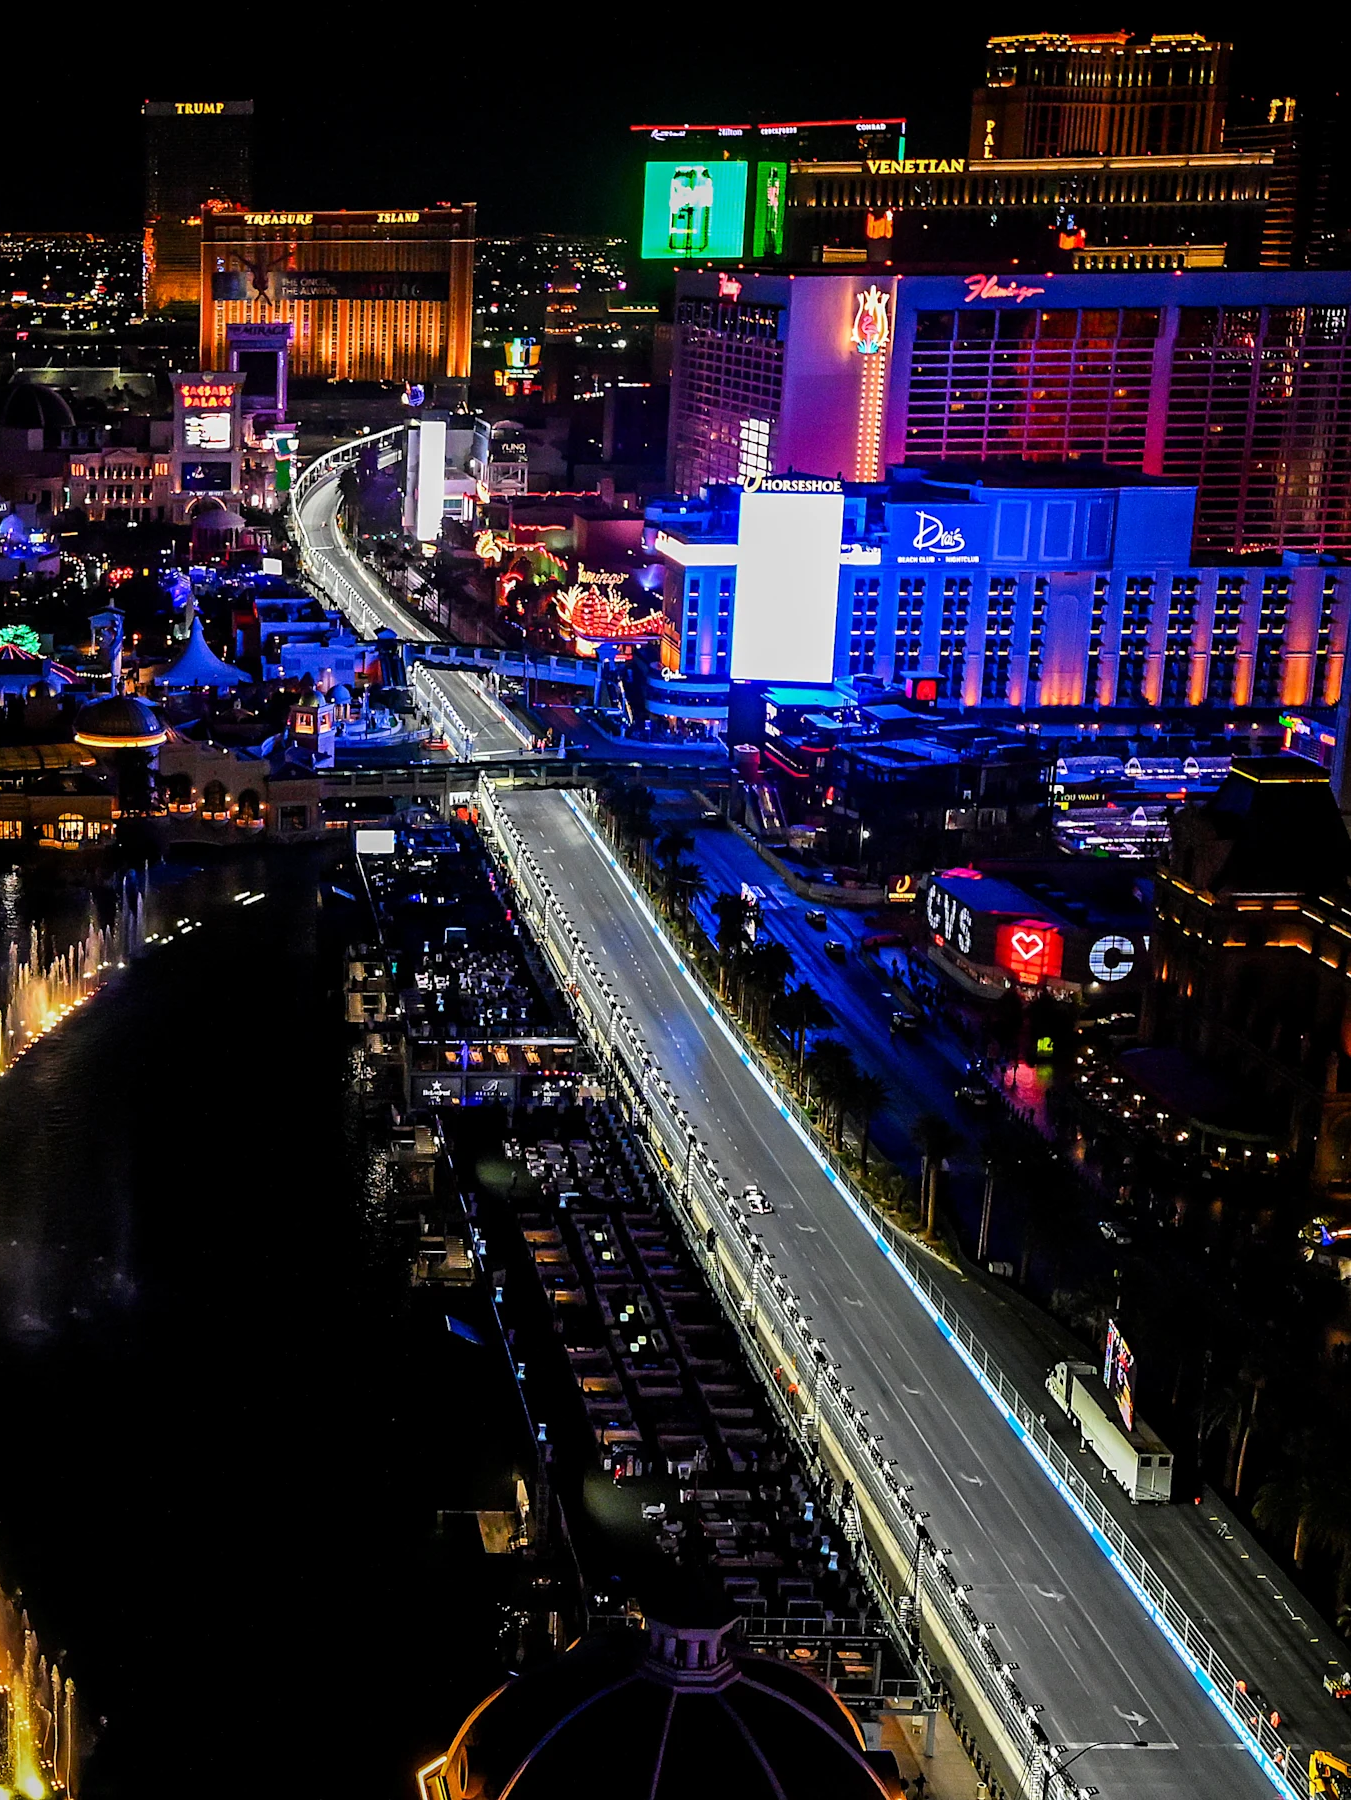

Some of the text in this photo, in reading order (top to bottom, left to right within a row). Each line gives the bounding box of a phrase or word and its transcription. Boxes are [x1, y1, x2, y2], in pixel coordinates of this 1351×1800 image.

[174, 102, 225, 115] TRUMP
[855, 123, 887, 132] CONRAD
[865, 158, 966, 175] VENETIAN
[244, 212, 420, 226] TREASURE ISLAND
[964, 273, 1045, 303] Flamingo
[181, 385, 234, 397] CAESARS
[183, 396, 232, 408] PALACE
[761, 480, 843, 493] HORSESHOE
[912, 511, 966, 553] Drai's
[919, 556, 935, 564] CLUB
[1077, 793, 1100, 801] WANT
[927, 884, 972, 954] CVS
